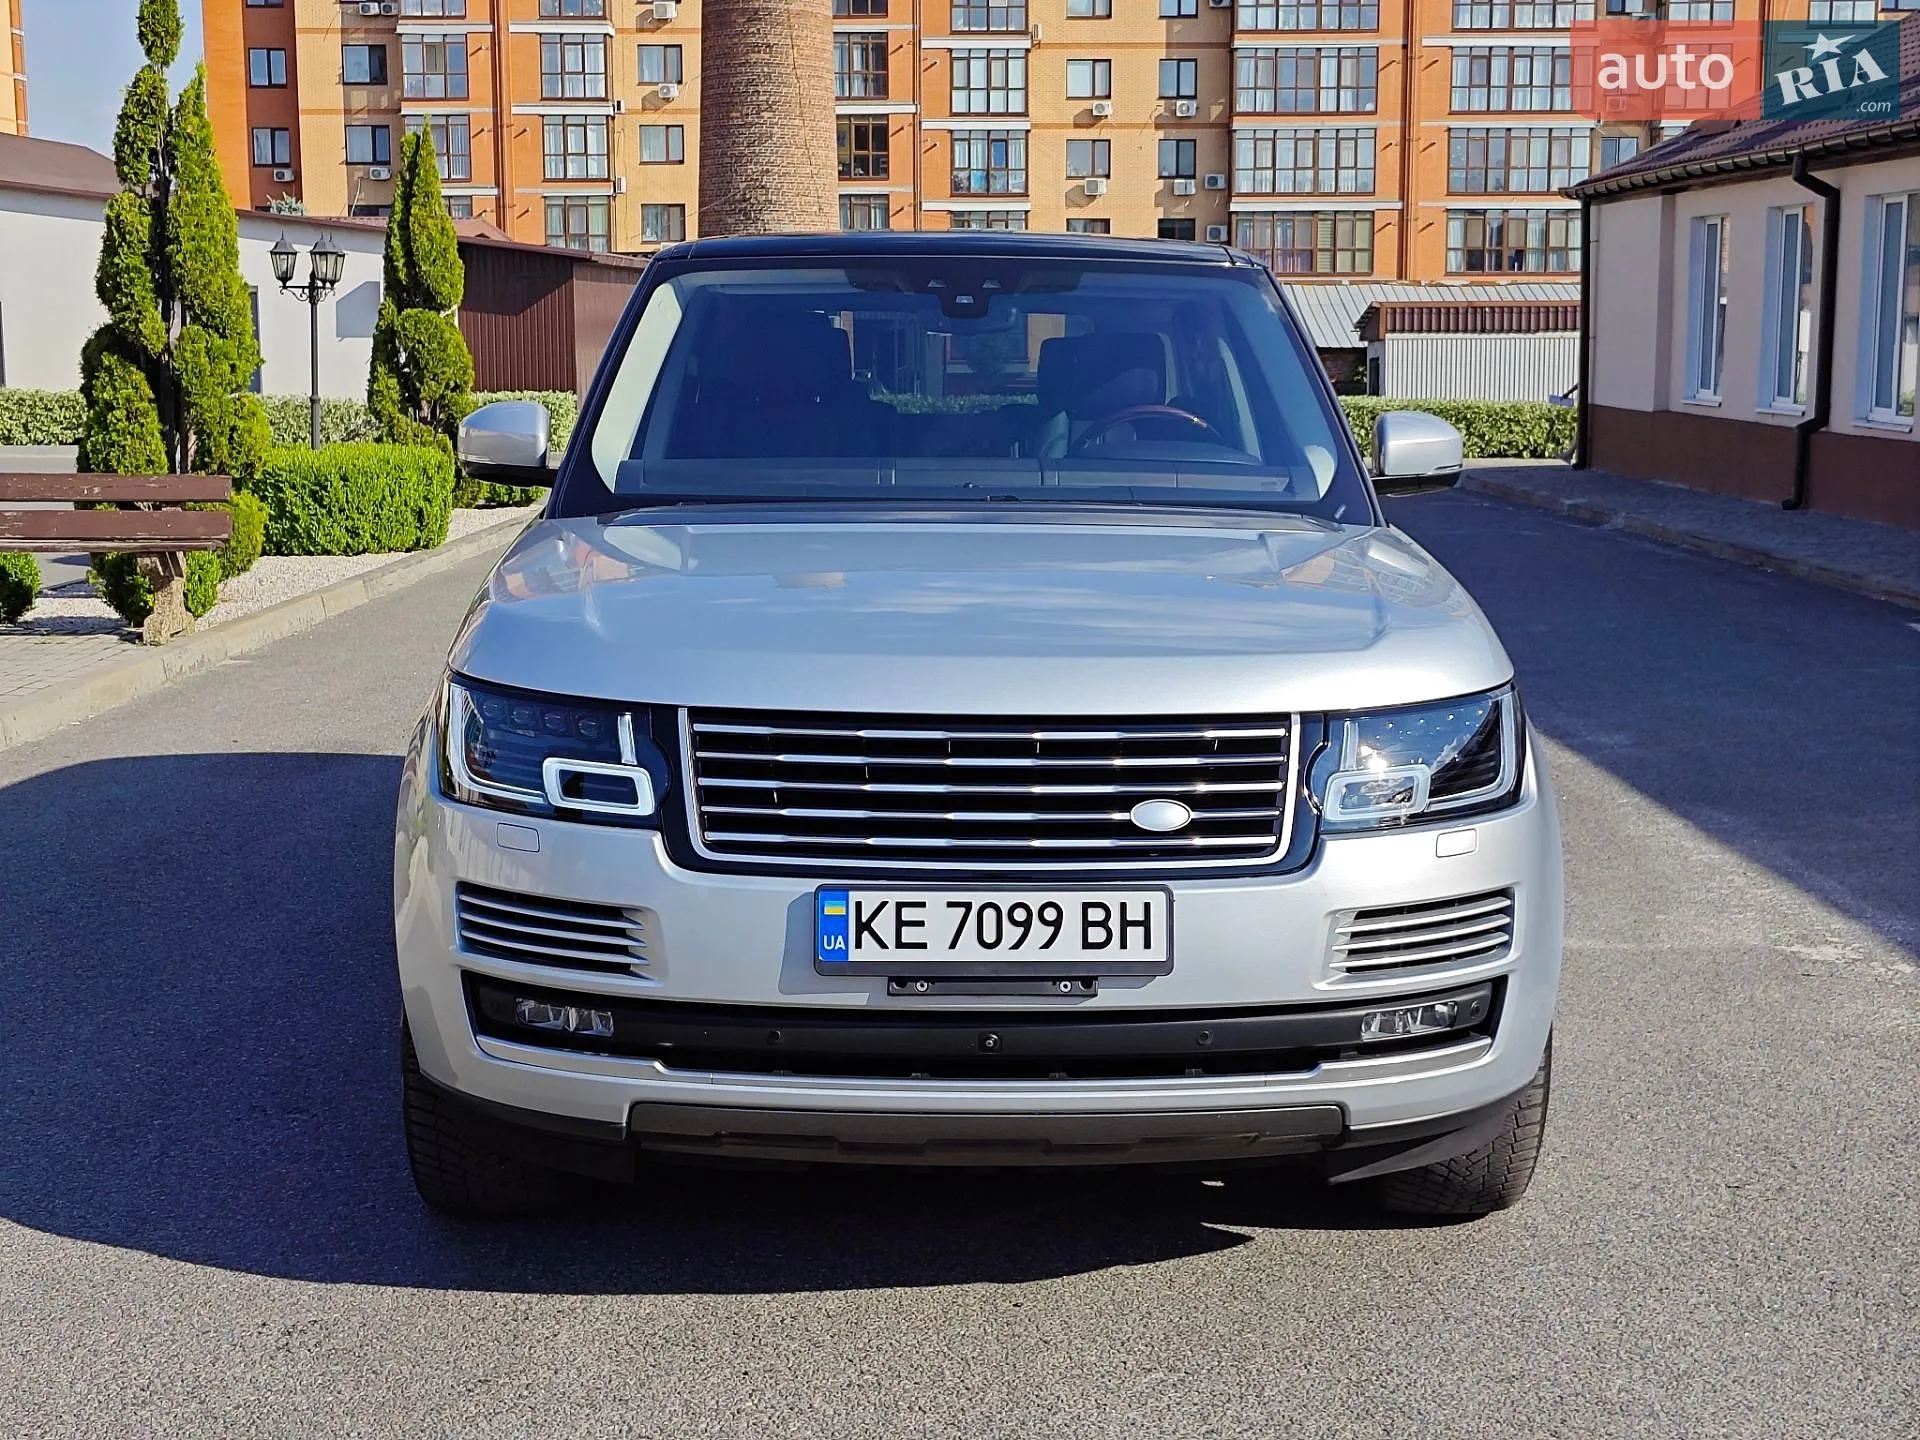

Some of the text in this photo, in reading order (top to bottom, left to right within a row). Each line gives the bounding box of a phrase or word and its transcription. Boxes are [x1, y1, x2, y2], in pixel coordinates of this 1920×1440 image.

[854, 900, 1151, 950] KE 7099 BH
[823, 935, 846, 950] UA
